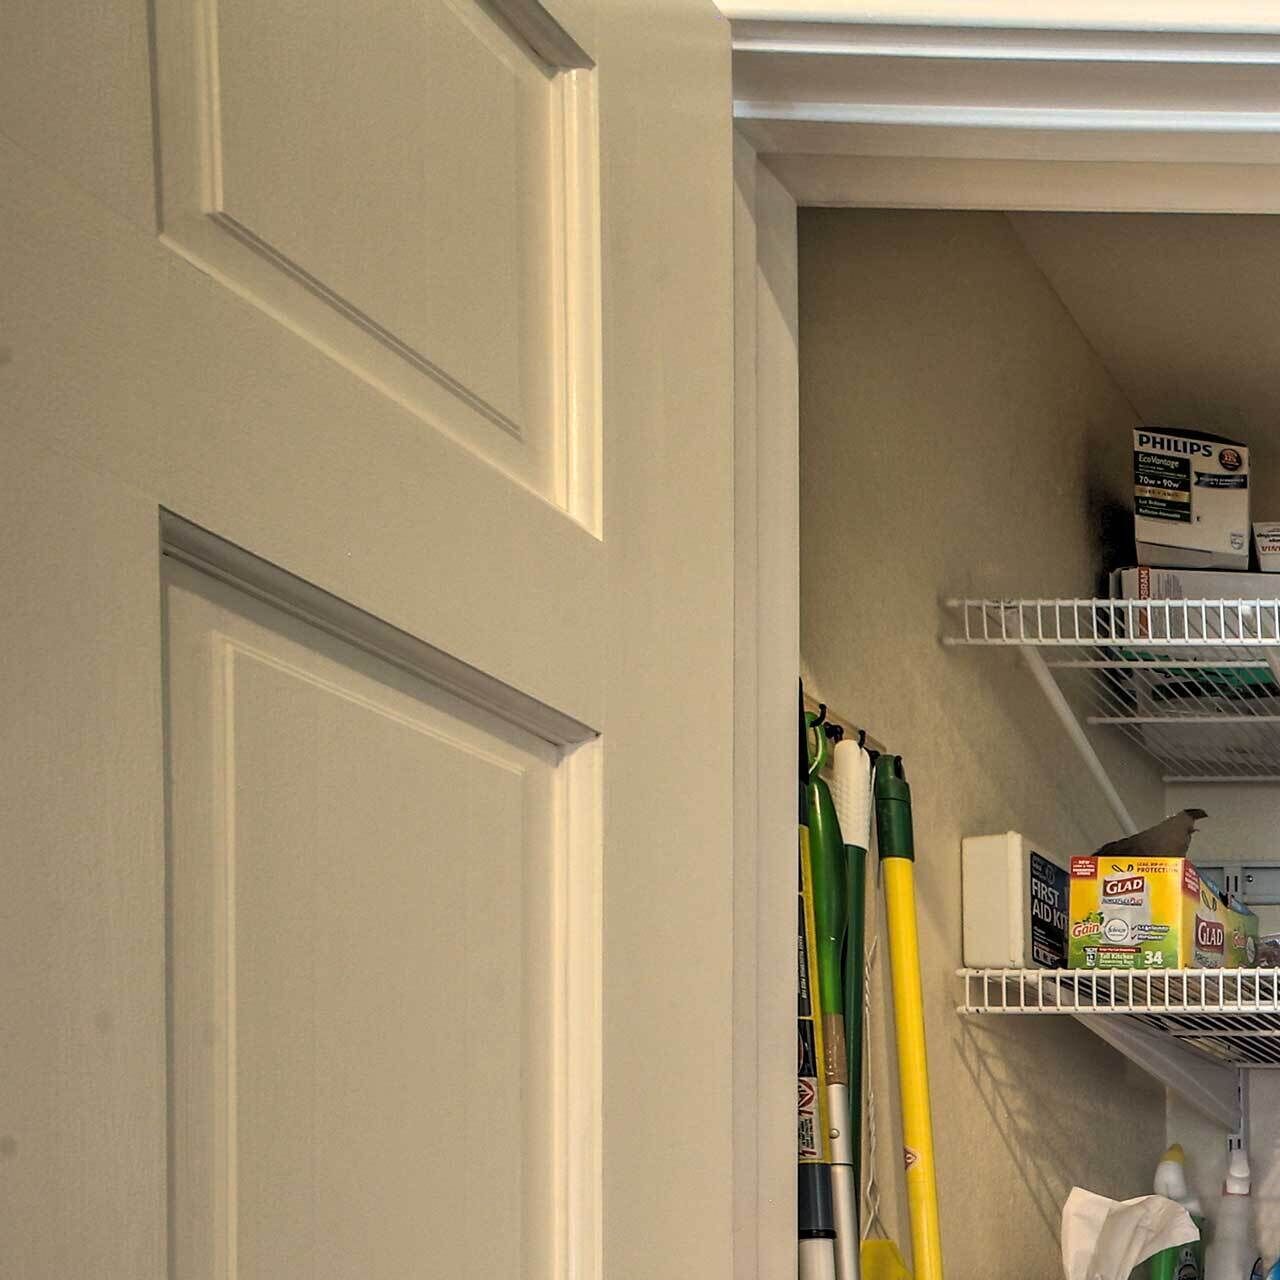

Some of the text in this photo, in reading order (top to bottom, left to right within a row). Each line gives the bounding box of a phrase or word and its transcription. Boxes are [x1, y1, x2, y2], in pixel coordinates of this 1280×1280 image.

[1138, 433, 1213, 458] PHILIPS
[1138, 453, 1180, 470] EcoVantage
[1140, 570, 1150, 600] OSRAM
[1032, 878, 1060, 908] FIRST
[1105, 879, 1143, 895] GLAD
[1033, 899, 1052, 923] AID
[1072, 922, 1101, 938] Gain
[1198, 921, 1224, 946] GLAD
[1143, 951, 1163, 965] 34
